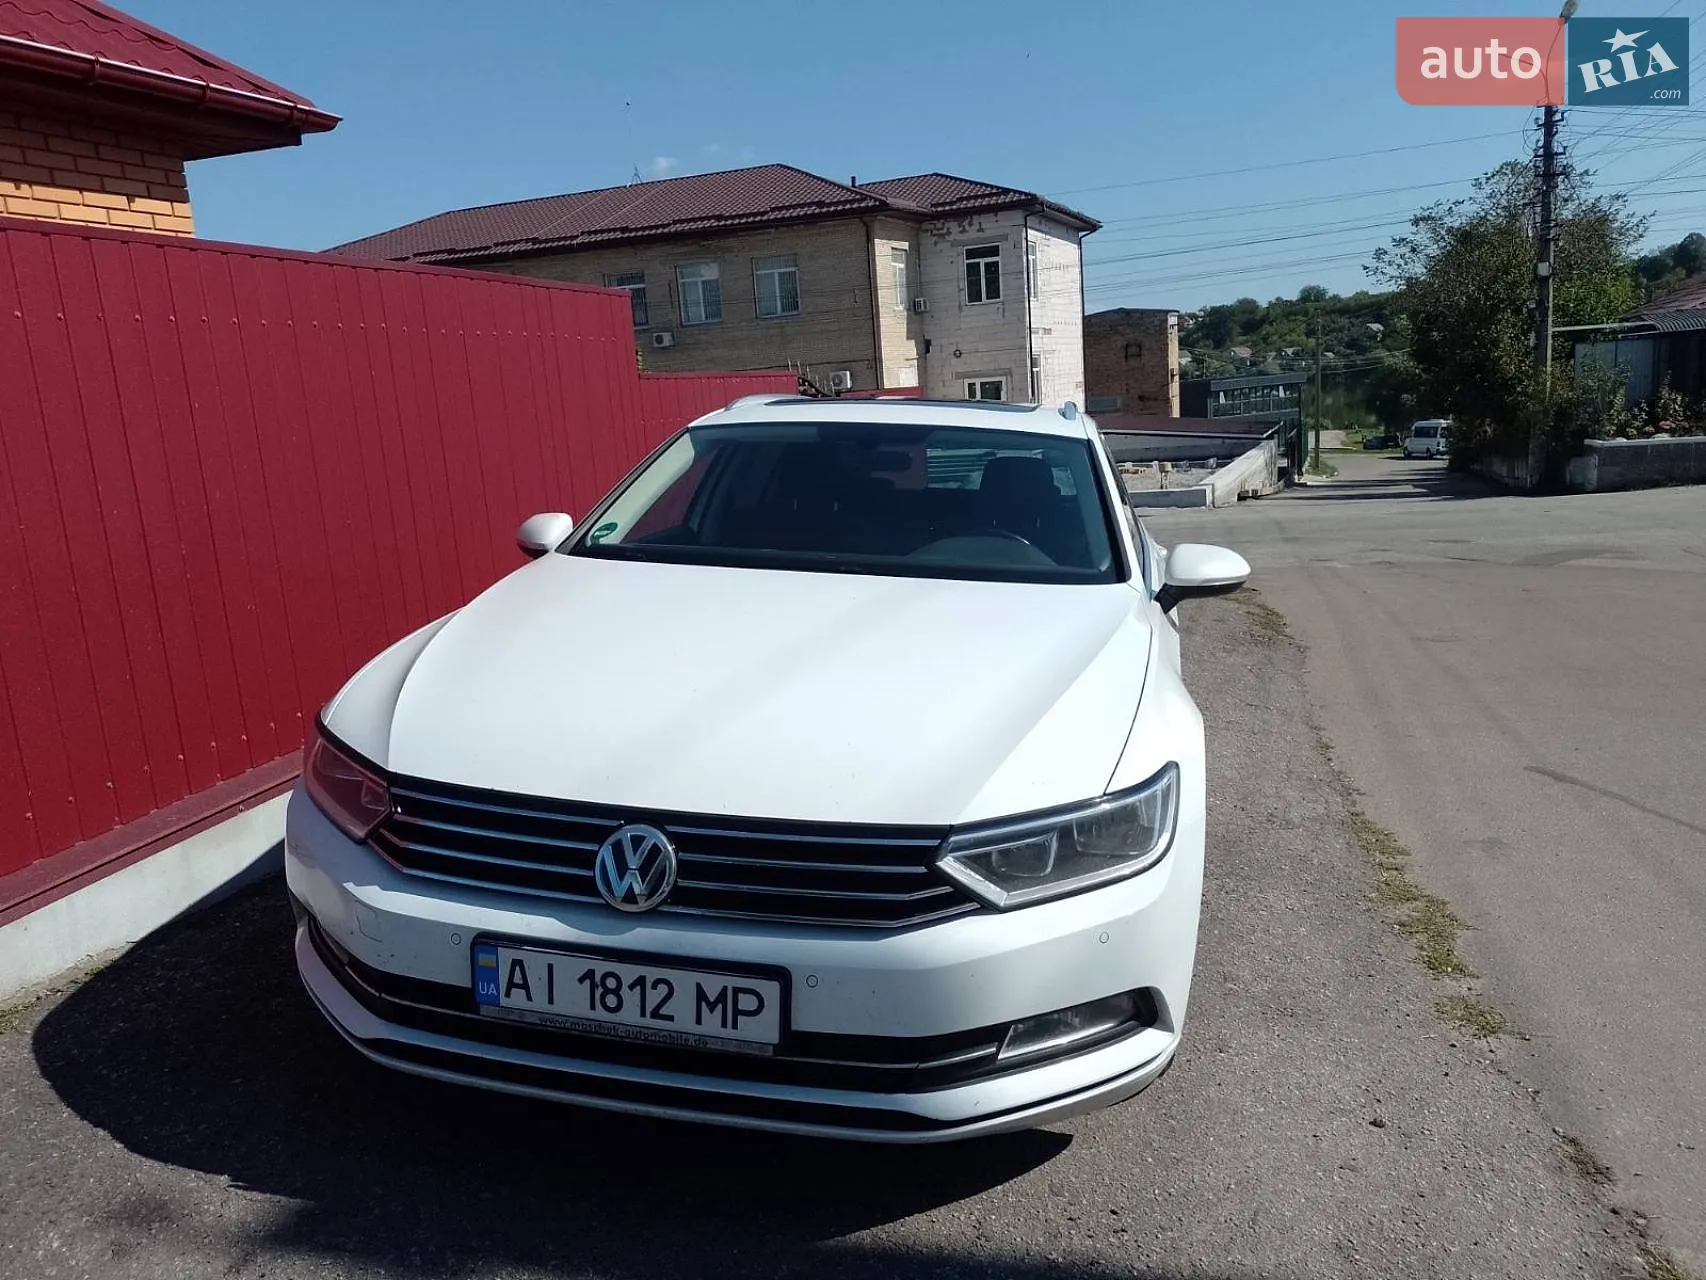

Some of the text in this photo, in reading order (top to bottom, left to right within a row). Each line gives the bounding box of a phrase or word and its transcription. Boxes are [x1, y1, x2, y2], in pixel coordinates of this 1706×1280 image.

[479, 981, 498, 996] UA
[576, 968, 676, 1023] 1812
[694, 981, 766, 1030] MP
